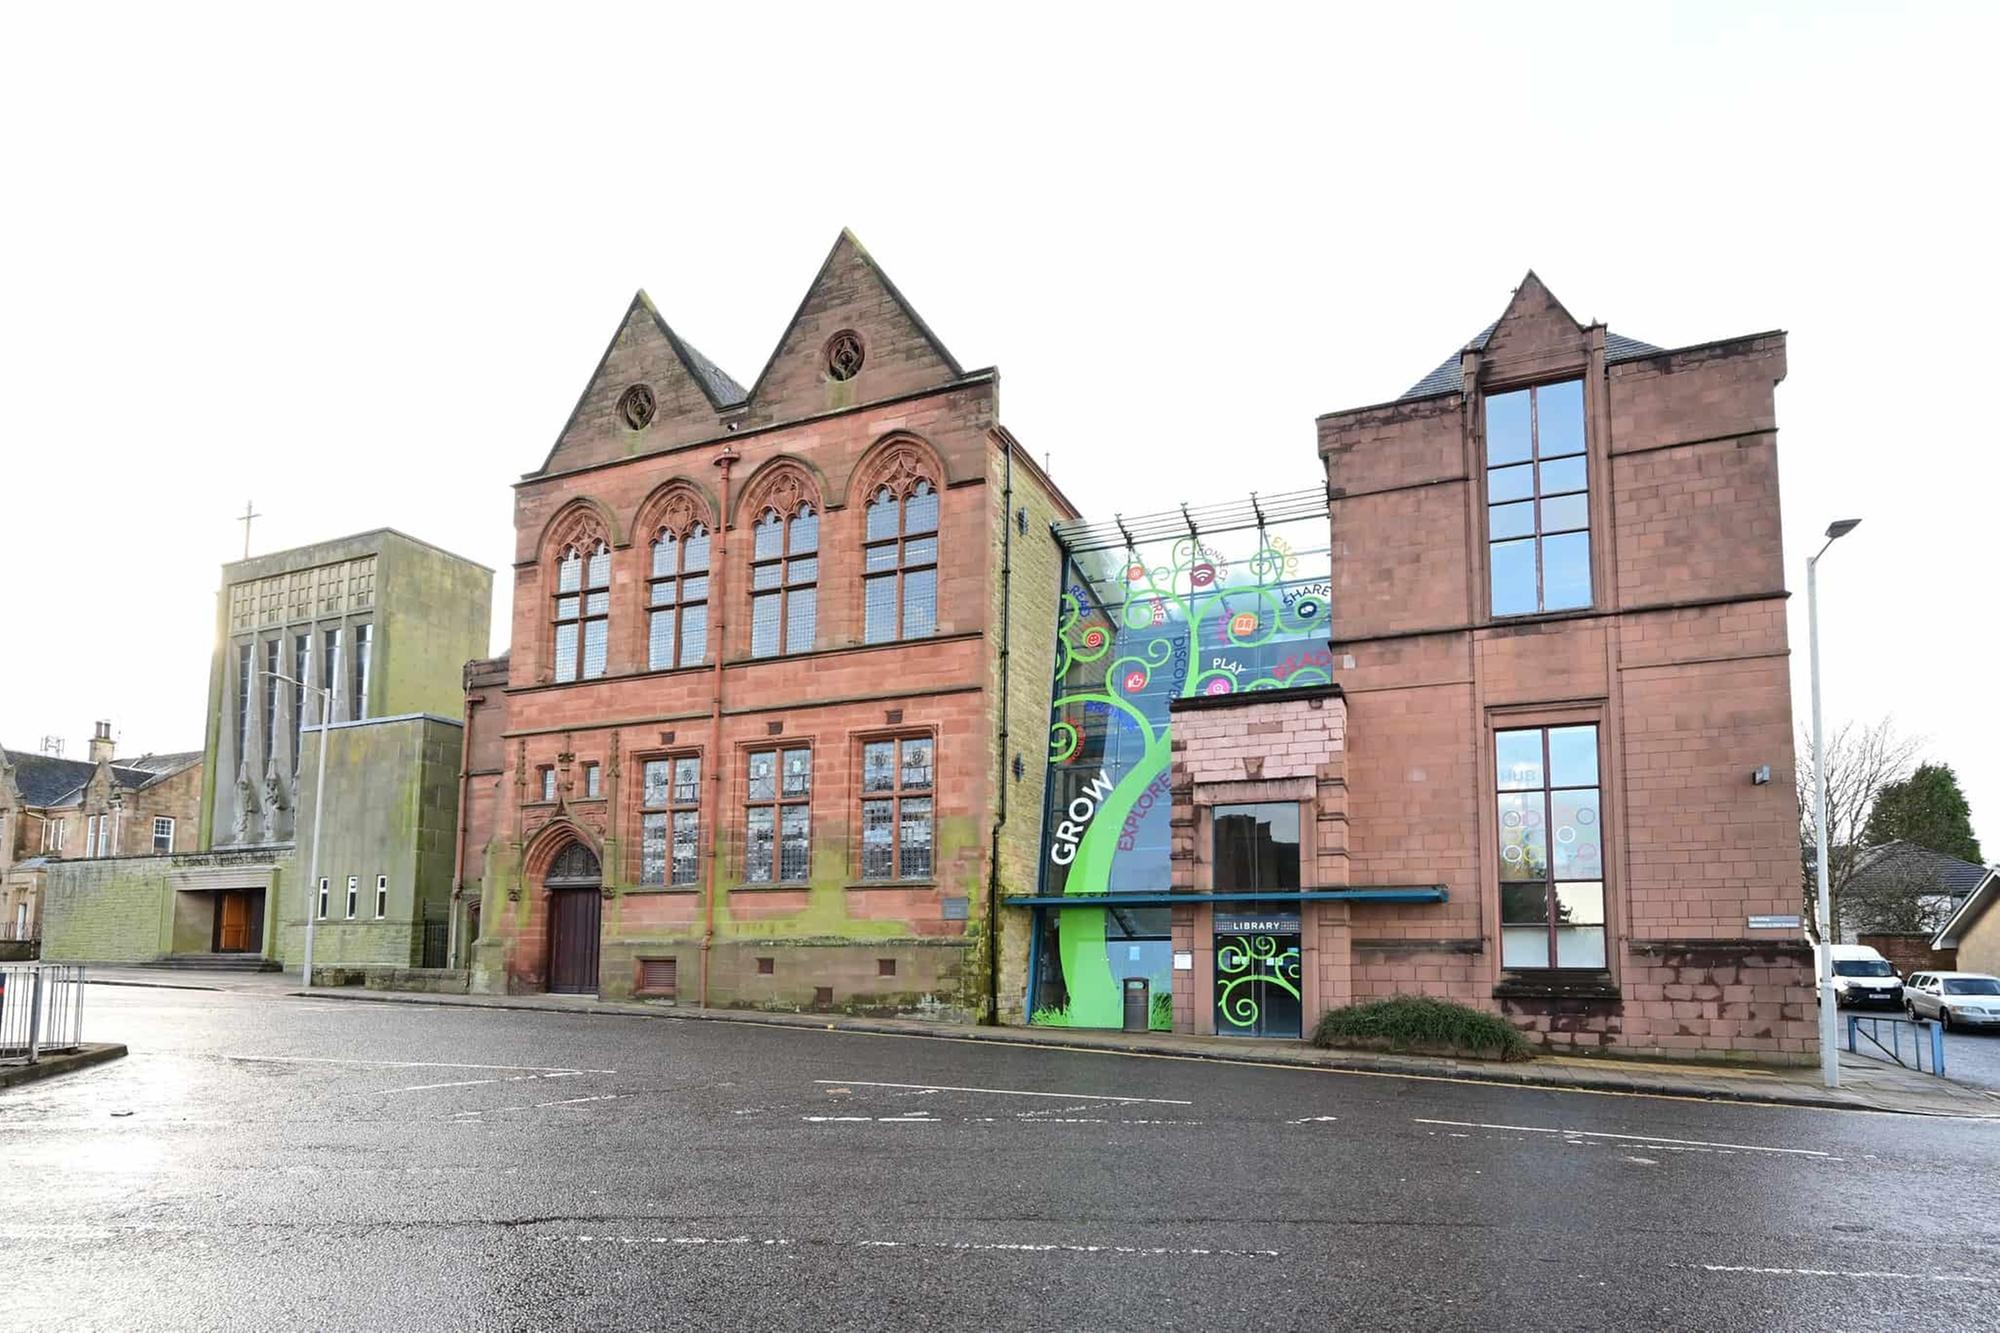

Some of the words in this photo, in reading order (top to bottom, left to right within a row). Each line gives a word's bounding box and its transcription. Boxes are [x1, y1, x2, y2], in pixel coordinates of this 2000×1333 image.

[1283, 584, 1331, 607] SHARE
[1212, 657, 1246, 676] PLAY
[1051, 769, 1114, 865] GROW
[1118, 772, 1171, 852] EXPLORE
[1234, 921, 1280, 931] LIBRARY
